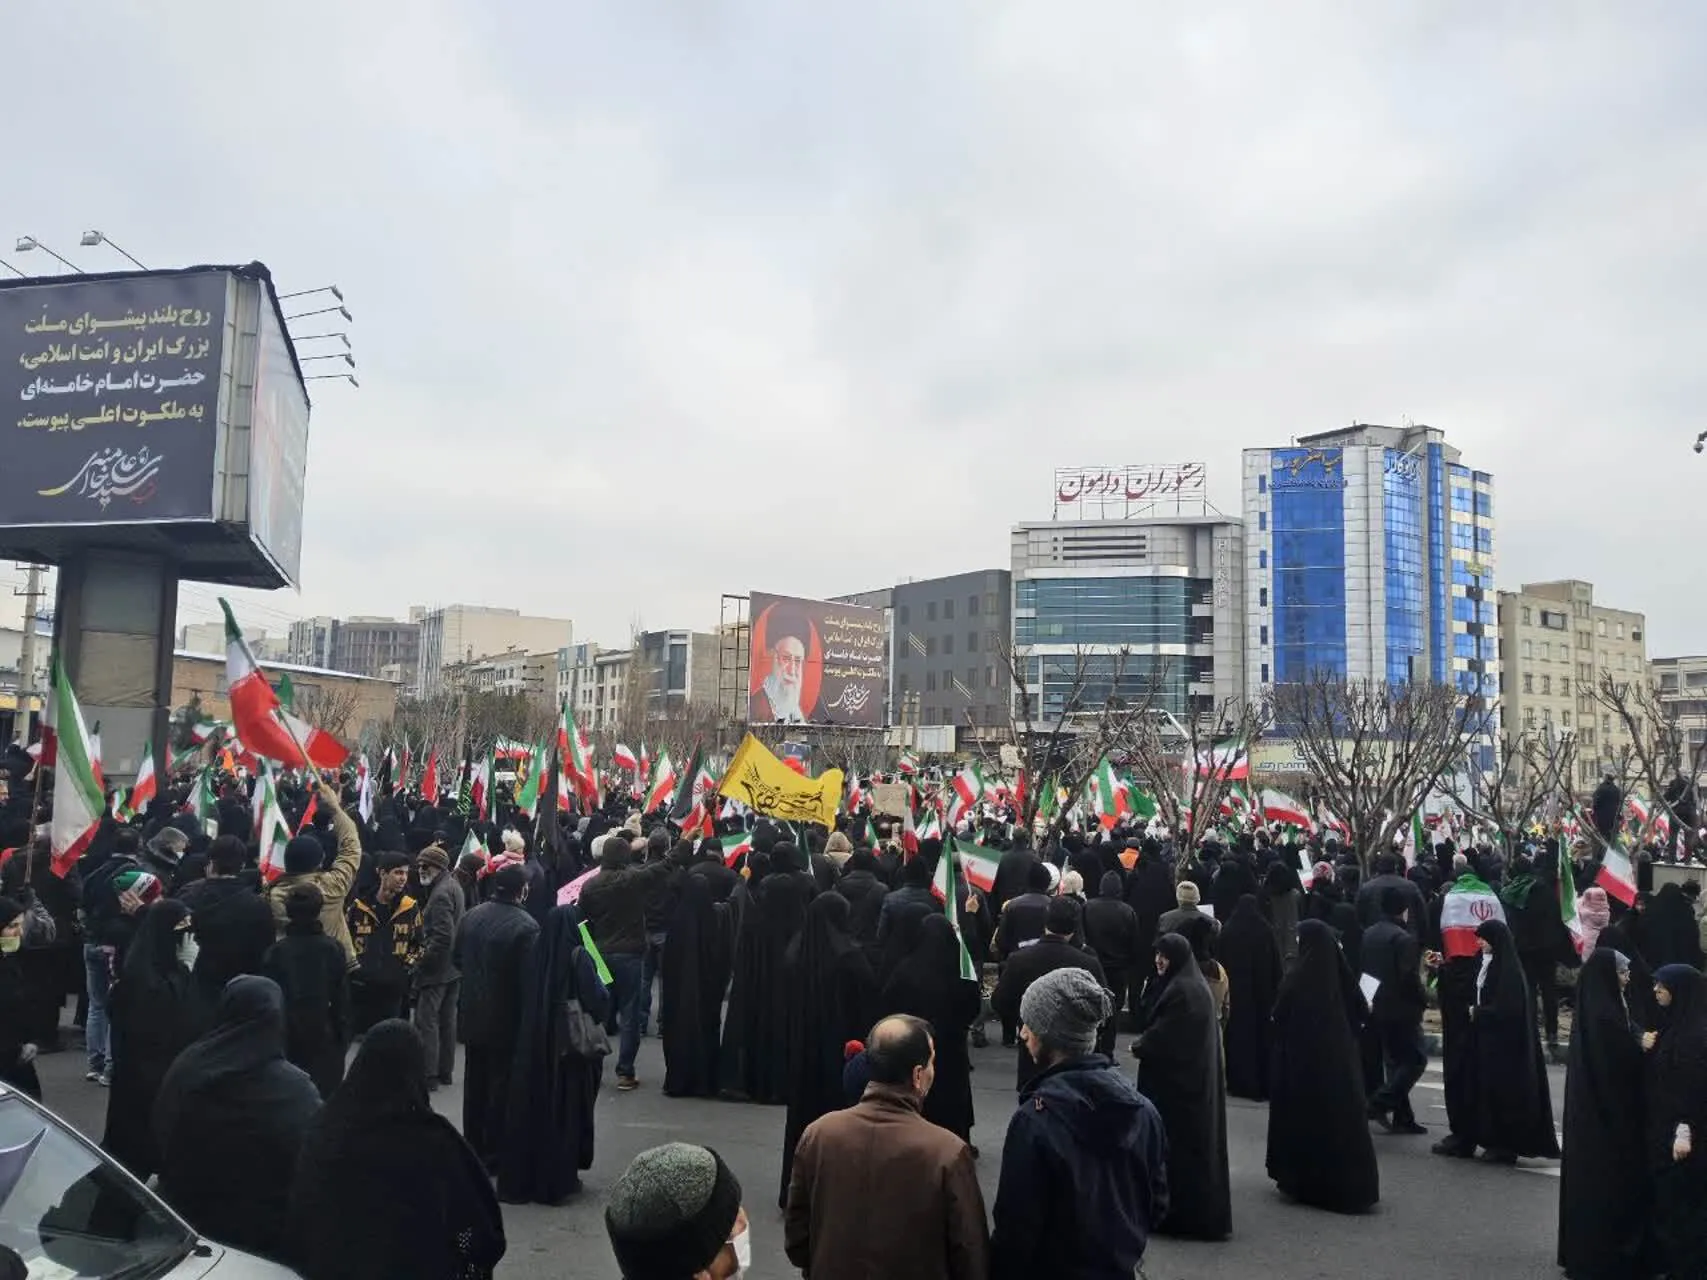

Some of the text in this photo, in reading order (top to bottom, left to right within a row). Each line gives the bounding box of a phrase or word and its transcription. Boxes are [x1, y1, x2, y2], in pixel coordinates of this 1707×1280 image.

[68, 308, 147, 335] پیشوای
[150, 304, 178, 326] بلند
[179, 308, 211, 326] روح
[111, 347, 121, 364] و
[123, 337, 163, 363] ایران
[166, 336, 210, 359] بزرگ
[95, 370, 139, 396] امام
[139, 368, 206, 393] حضرت
[71, 403, 120, 430] اعلی
[123, 400, 185, 427] ملکوت
[188, 403, 204, 422] به
[1125, 464, 1204, 499] رستوران
